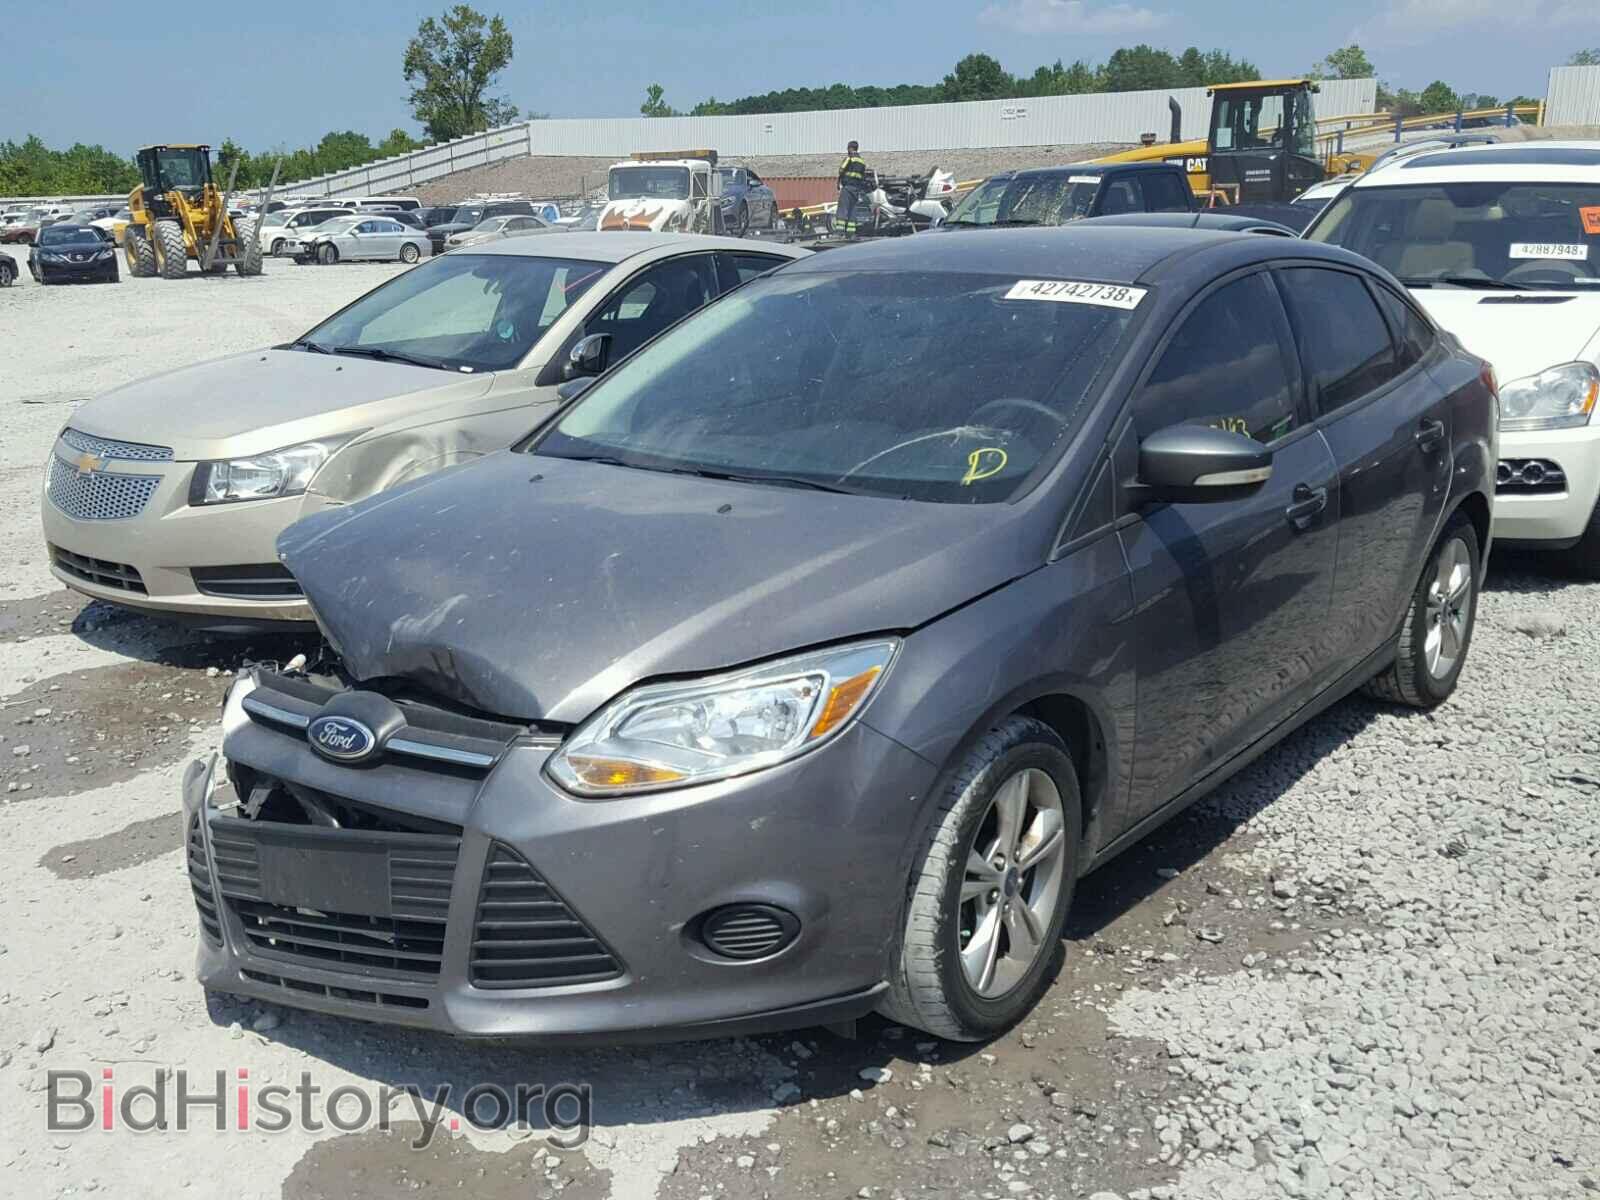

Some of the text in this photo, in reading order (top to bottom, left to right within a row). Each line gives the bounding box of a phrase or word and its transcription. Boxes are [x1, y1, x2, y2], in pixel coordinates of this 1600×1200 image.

[1186, 158, 1208, 172] CAT
[961, 447, 1008, 486] D
[319, 722, 357, 749] Ford
